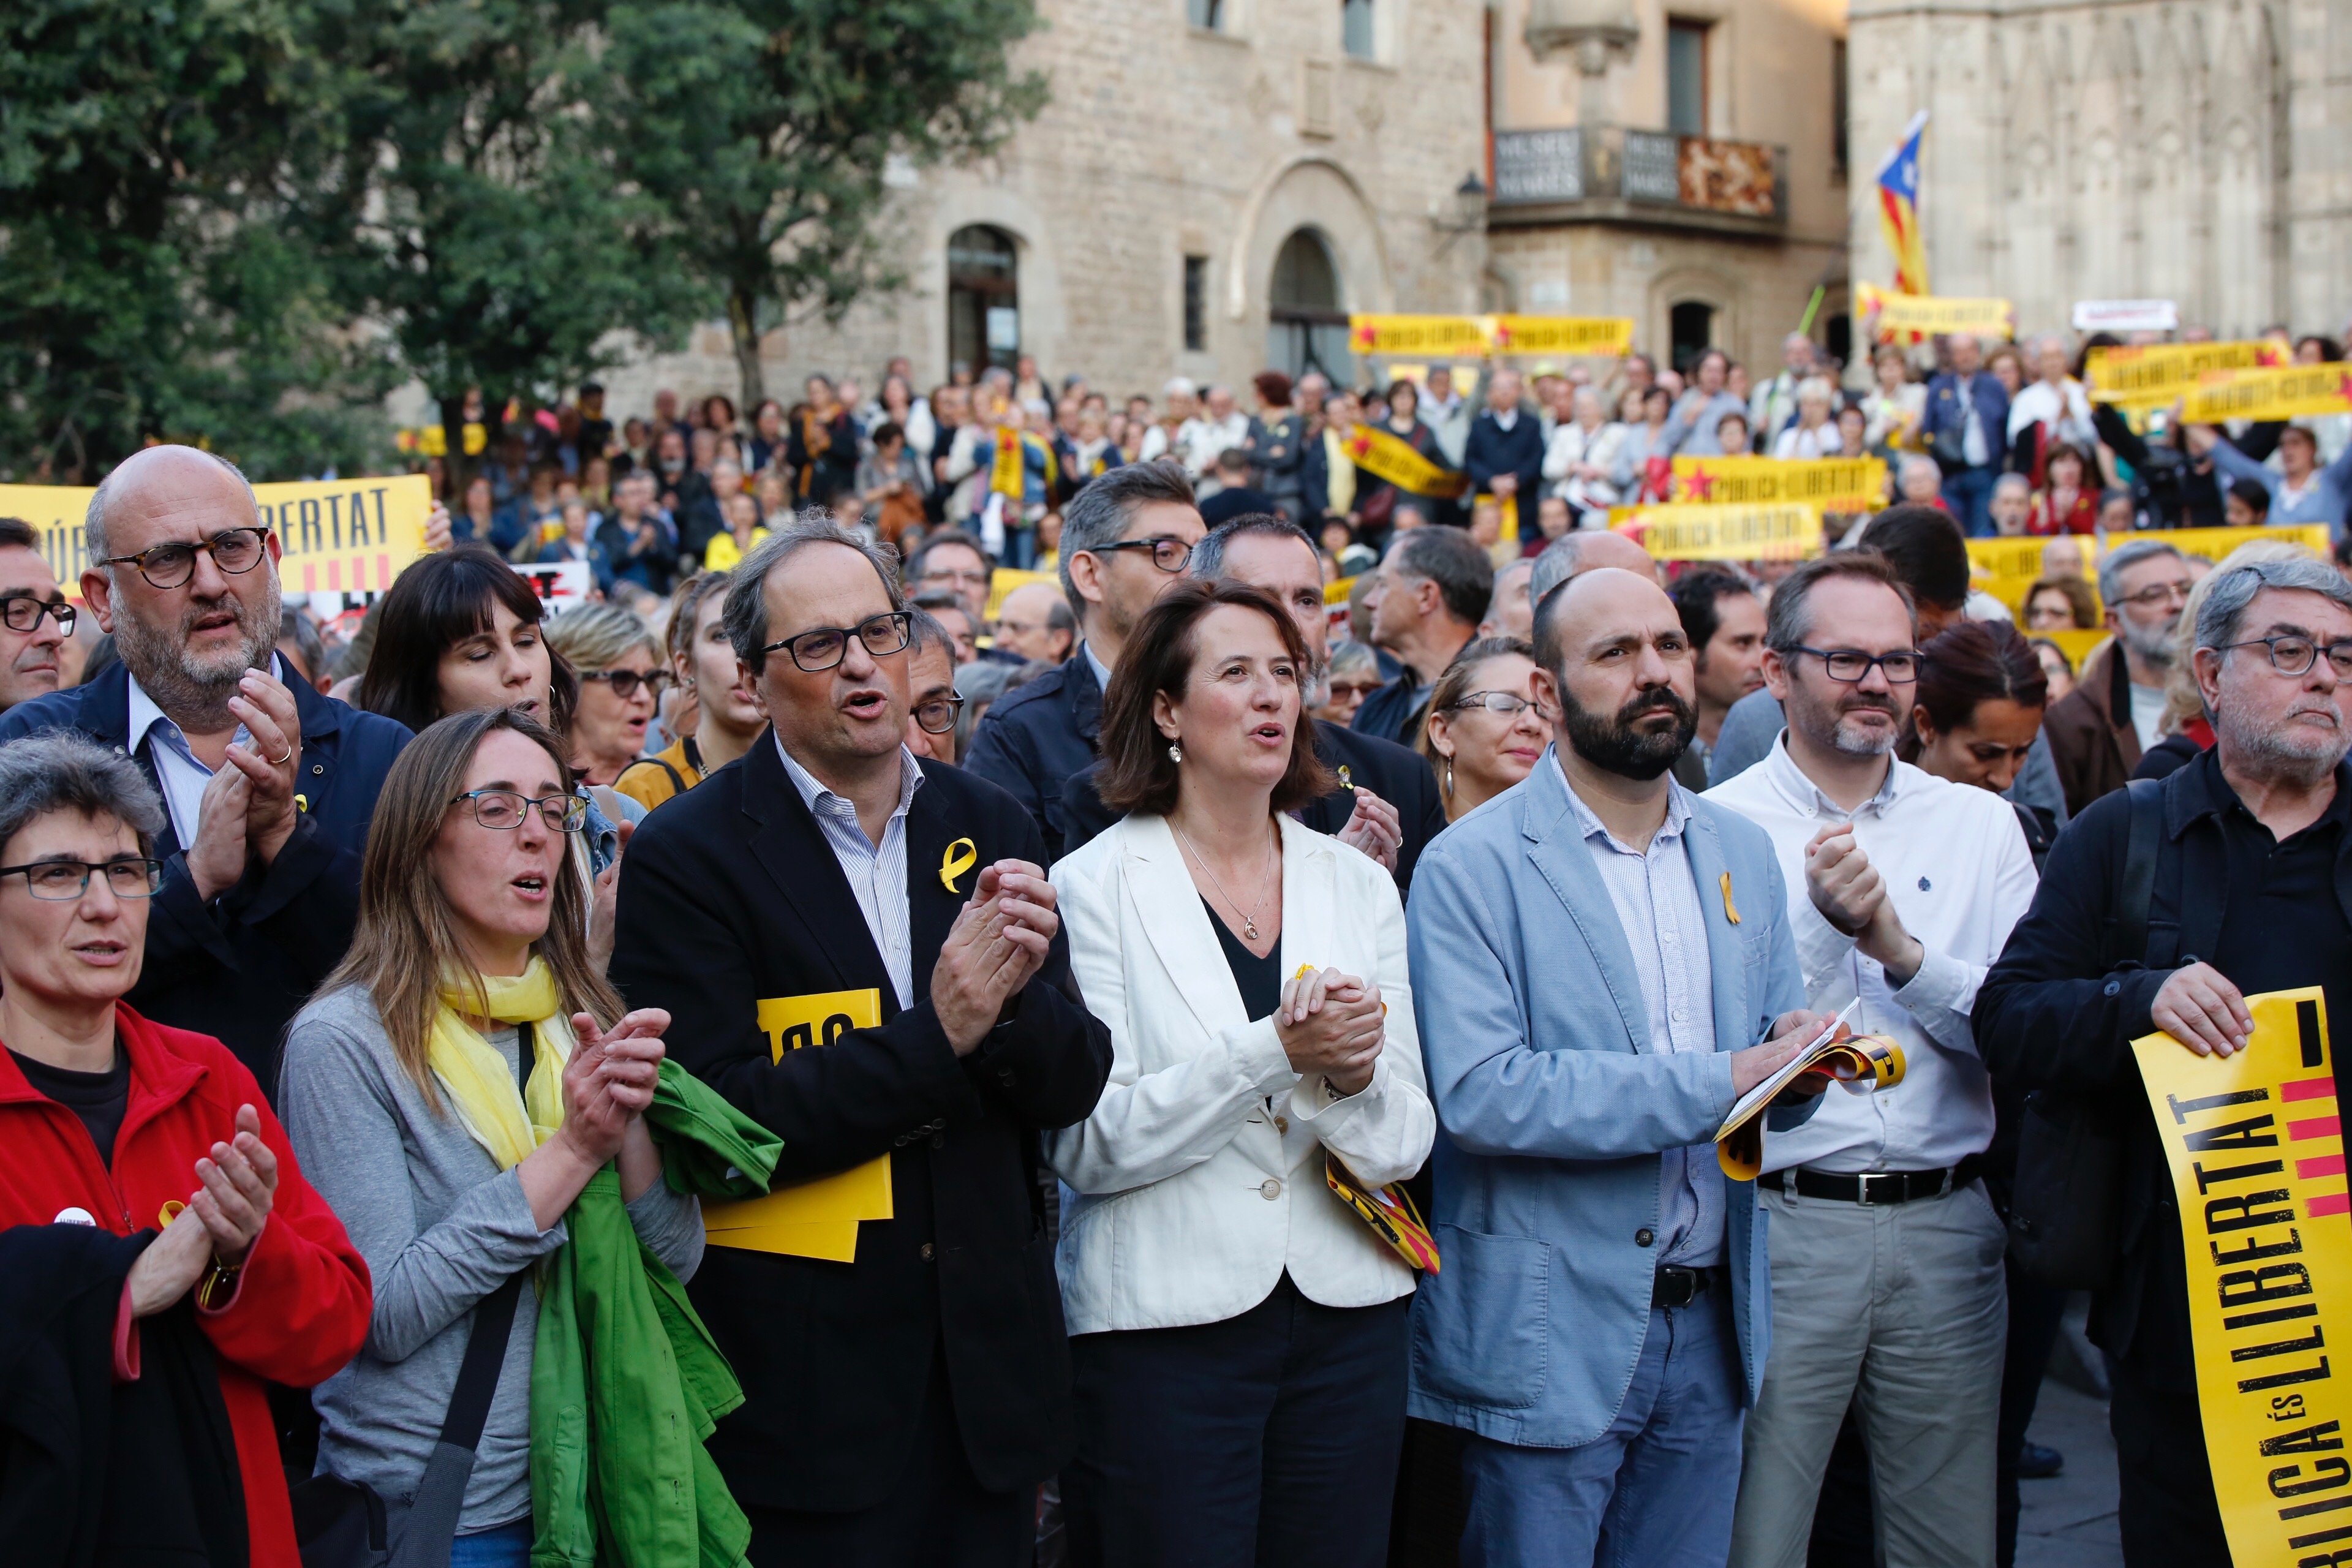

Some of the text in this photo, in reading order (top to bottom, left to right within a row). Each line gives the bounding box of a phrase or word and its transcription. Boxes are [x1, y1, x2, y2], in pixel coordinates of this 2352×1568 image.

[260, 487, 389, 556] ERTAT
[2166, 1088, 2331, 1393] LLIBERTAT
[2267, 1393, 2306, 1422] ÉS
